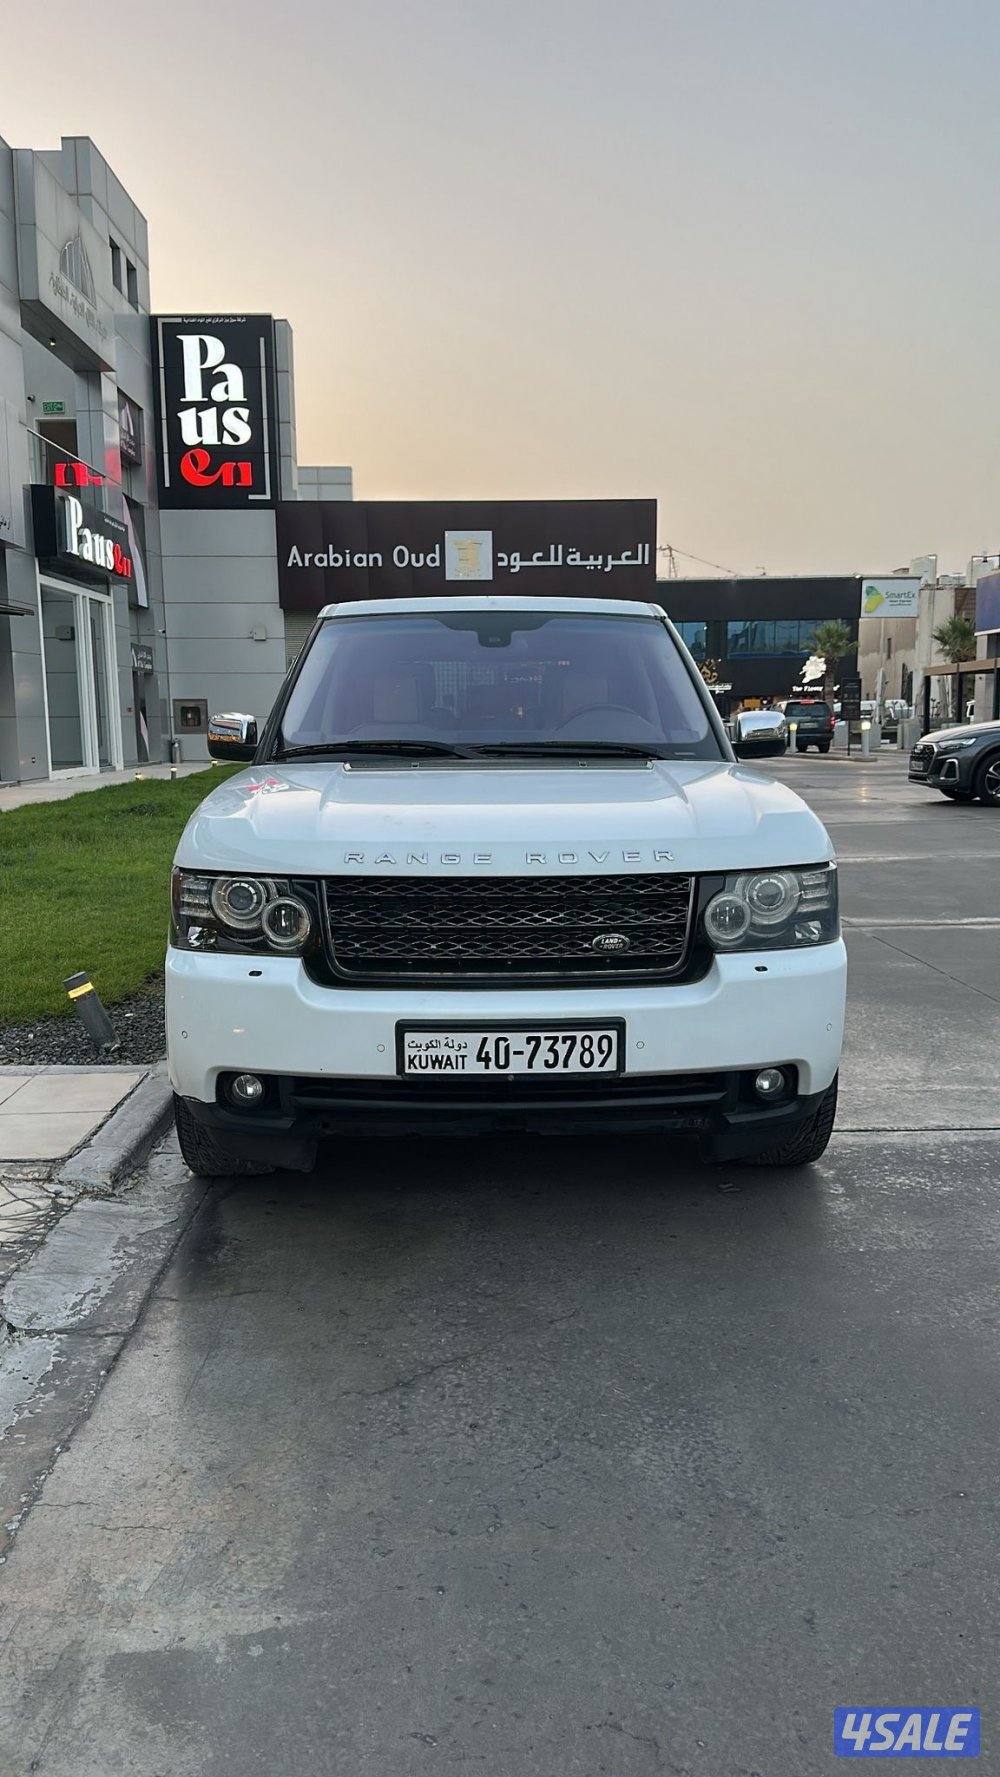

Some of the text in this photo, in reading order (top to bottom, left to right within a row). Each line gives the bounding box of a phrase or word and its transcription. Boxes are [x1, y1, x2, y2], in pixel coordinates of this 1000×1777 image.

[176, 335, 248, 402] Pa
[177, 406, 252, 446] us
[180, 448, 254, 487] en
[65, 495, 132, 577] Pausen
[287, 544, 440, 568] Arabian Oud
[497, 543, 650, 573] العربية للعود
[343, 849, 676, 865] RANGE ROVER
[407, 1036, 468, 1053] دولة الكويت
[476, 1034, 613, 1070] 40-73789
[407, 1054, 468, 1070] KUWAIT
